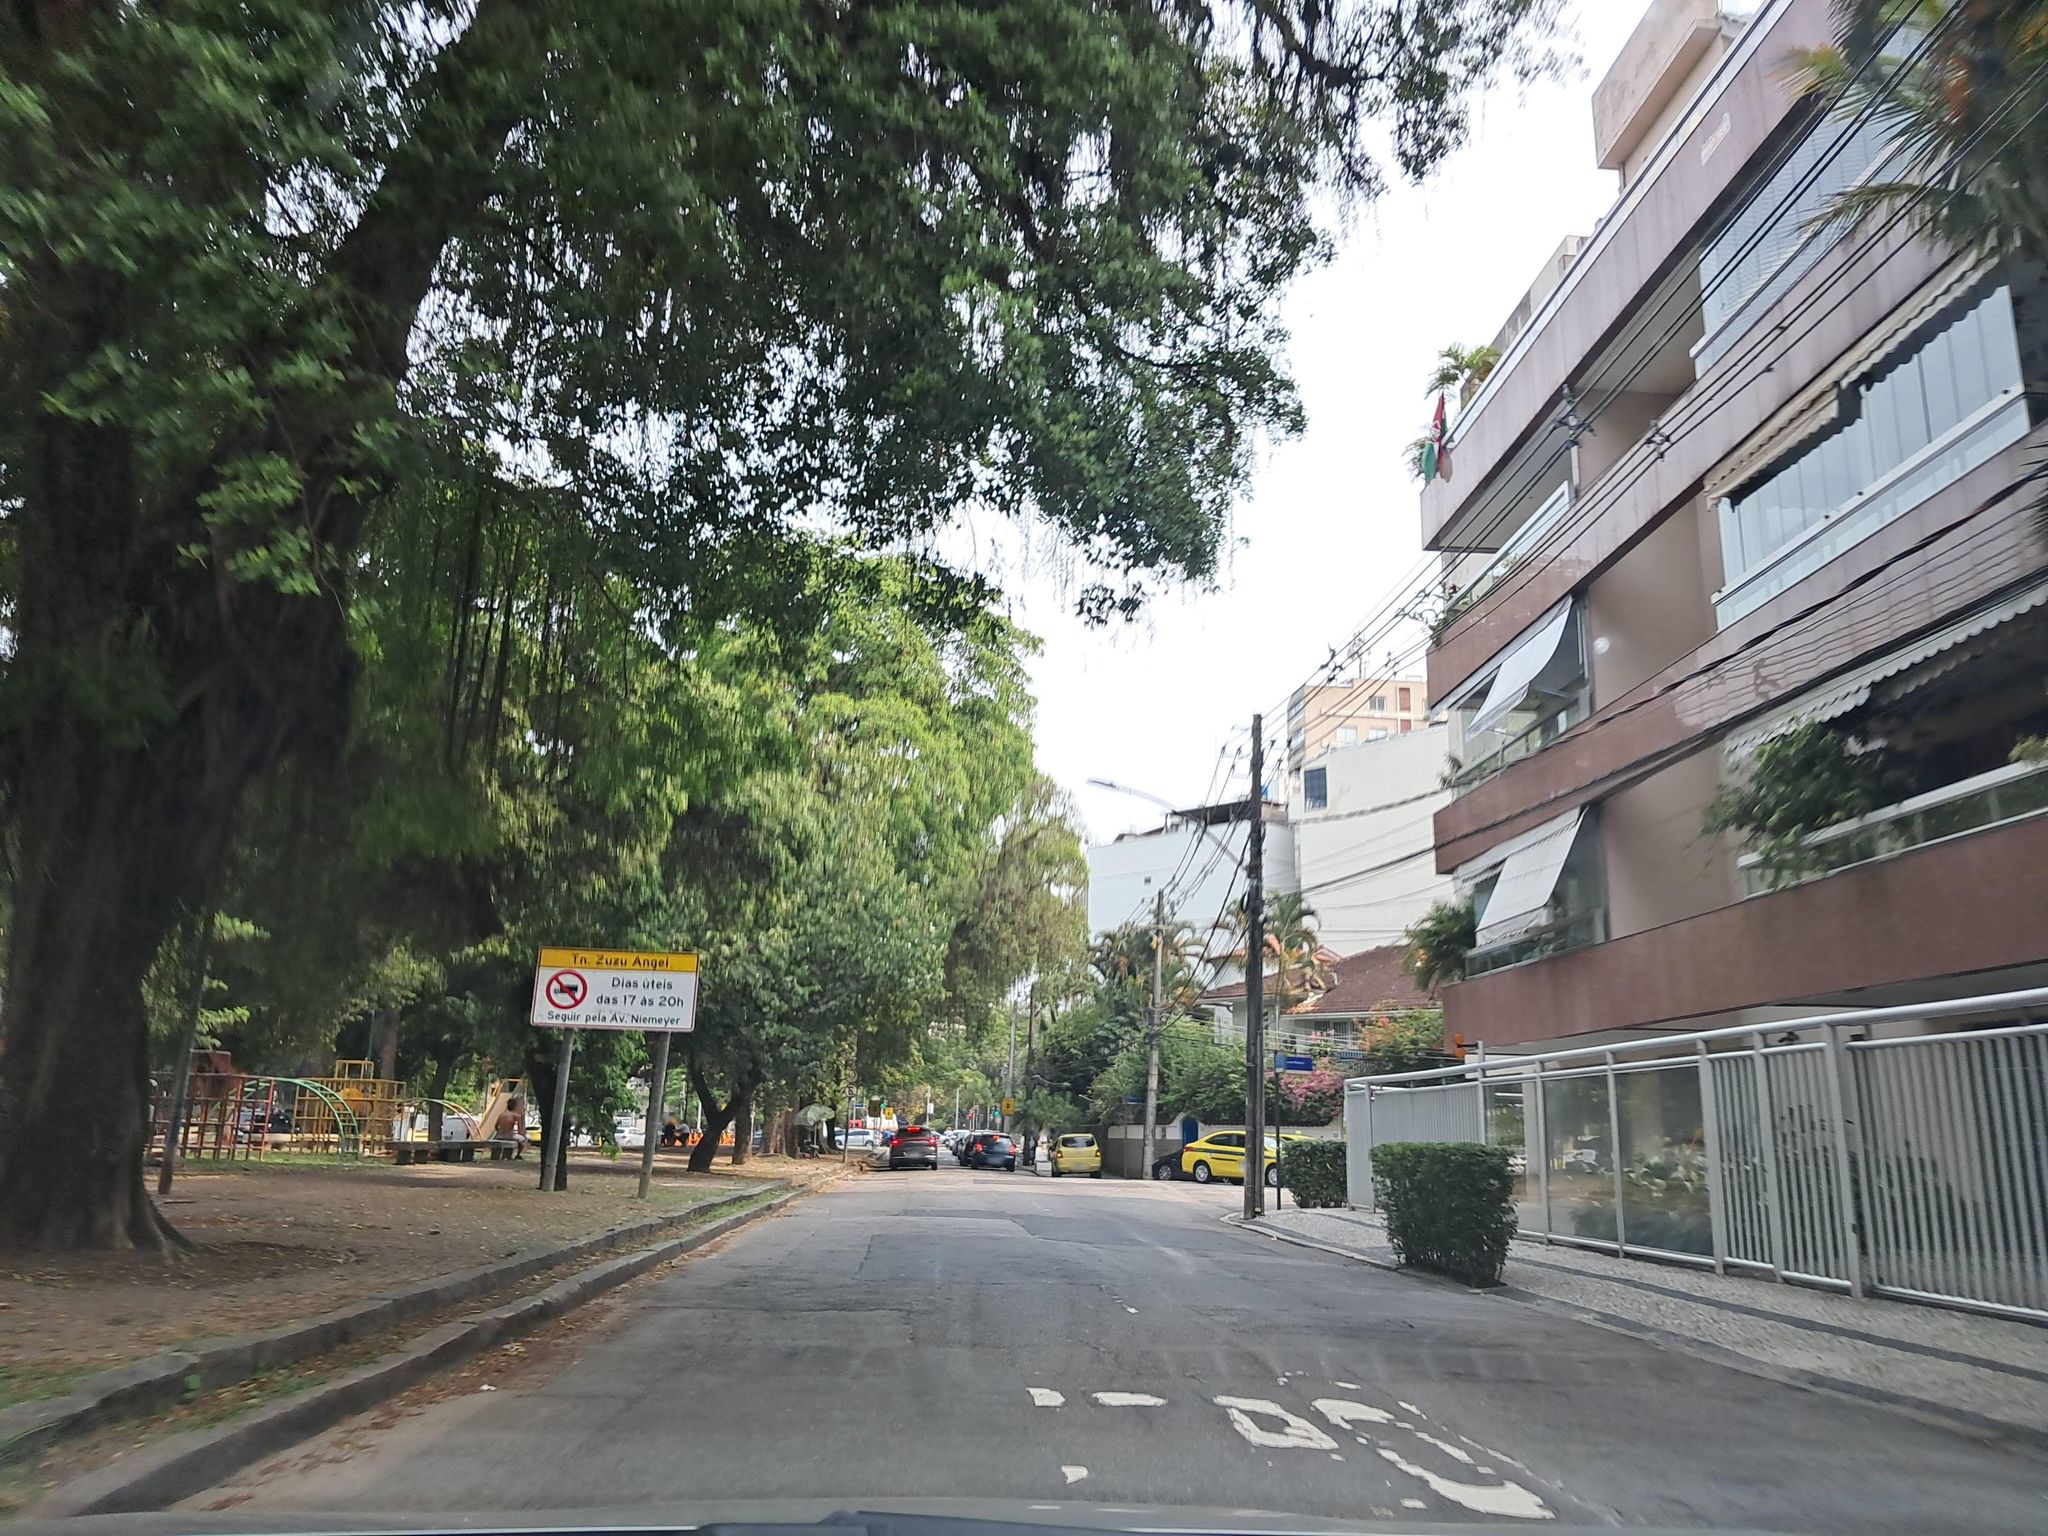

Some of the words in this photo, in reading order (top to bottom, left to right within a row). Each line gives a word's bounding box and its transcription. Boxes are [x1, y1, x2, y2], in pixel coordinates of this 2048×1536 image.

[572, 953, 590, 965] Tn.
[595, 954, 628, 967] Zuzu
[632, 956, 669, 971] Angel
[611, 977, 638, 990] Dias
[642, 977, 673, 990] úteis
[596, 994, 618, 1005] das
[623, 994, 636, 1006] 17
[658, 995, 684, 1008] 20h
[547, 1011, 581, 1023] Seguir
[585, 1012, 607, 1023] pela
[631, 1014, 680, 1027] Niemeyer
